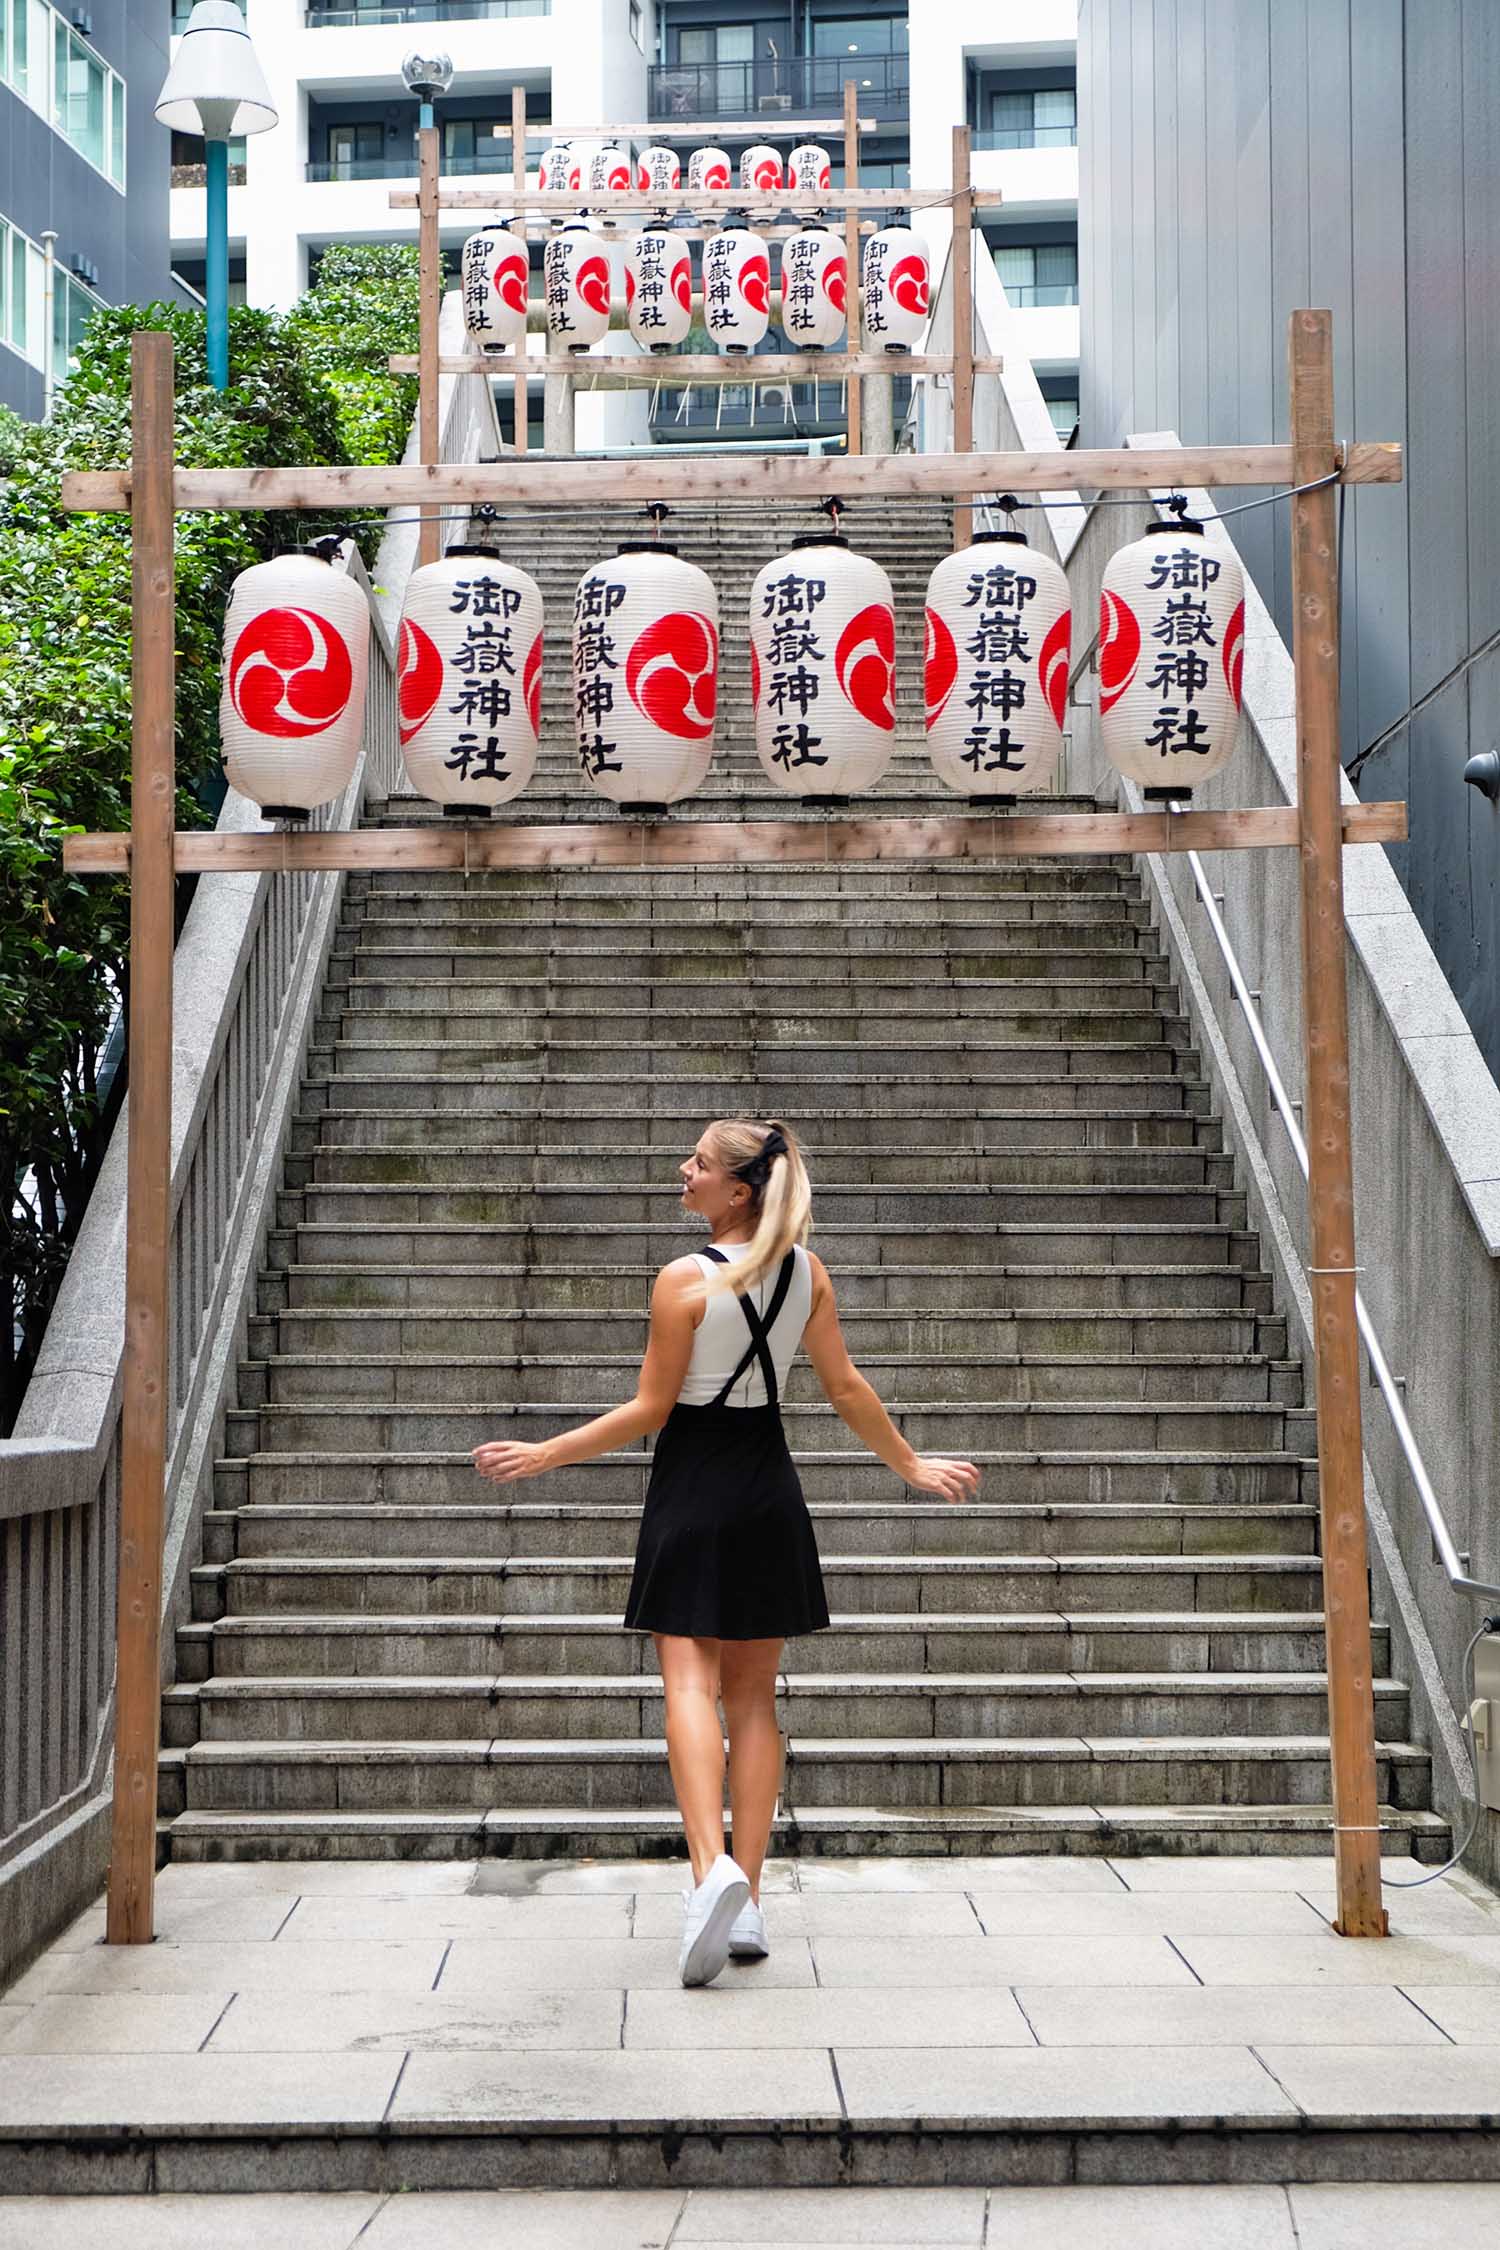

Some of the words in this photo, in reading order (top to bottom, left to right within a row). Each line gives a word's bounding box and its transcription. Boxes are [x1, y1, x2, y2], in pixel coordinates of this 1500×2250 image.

[465, 239, 494, 332] 御嶽神社
[543, 240, 577, 334] 御嶽神社
[635, 237, 667, 329] 御嶽神社
[706, 239, 740, 331] 御嶽神社
[788, 237, 821, 331] 御嶽神社
[444, 576, 522, 782] 御嶽神社
[573, 576, 627, 782] 御嶽神社
[761, 573, 829, 773] 御嶽神社
[960, 564, 1037, 773] 御嶽神社
[1144, 547, 1222, 757] 御嶽神社
